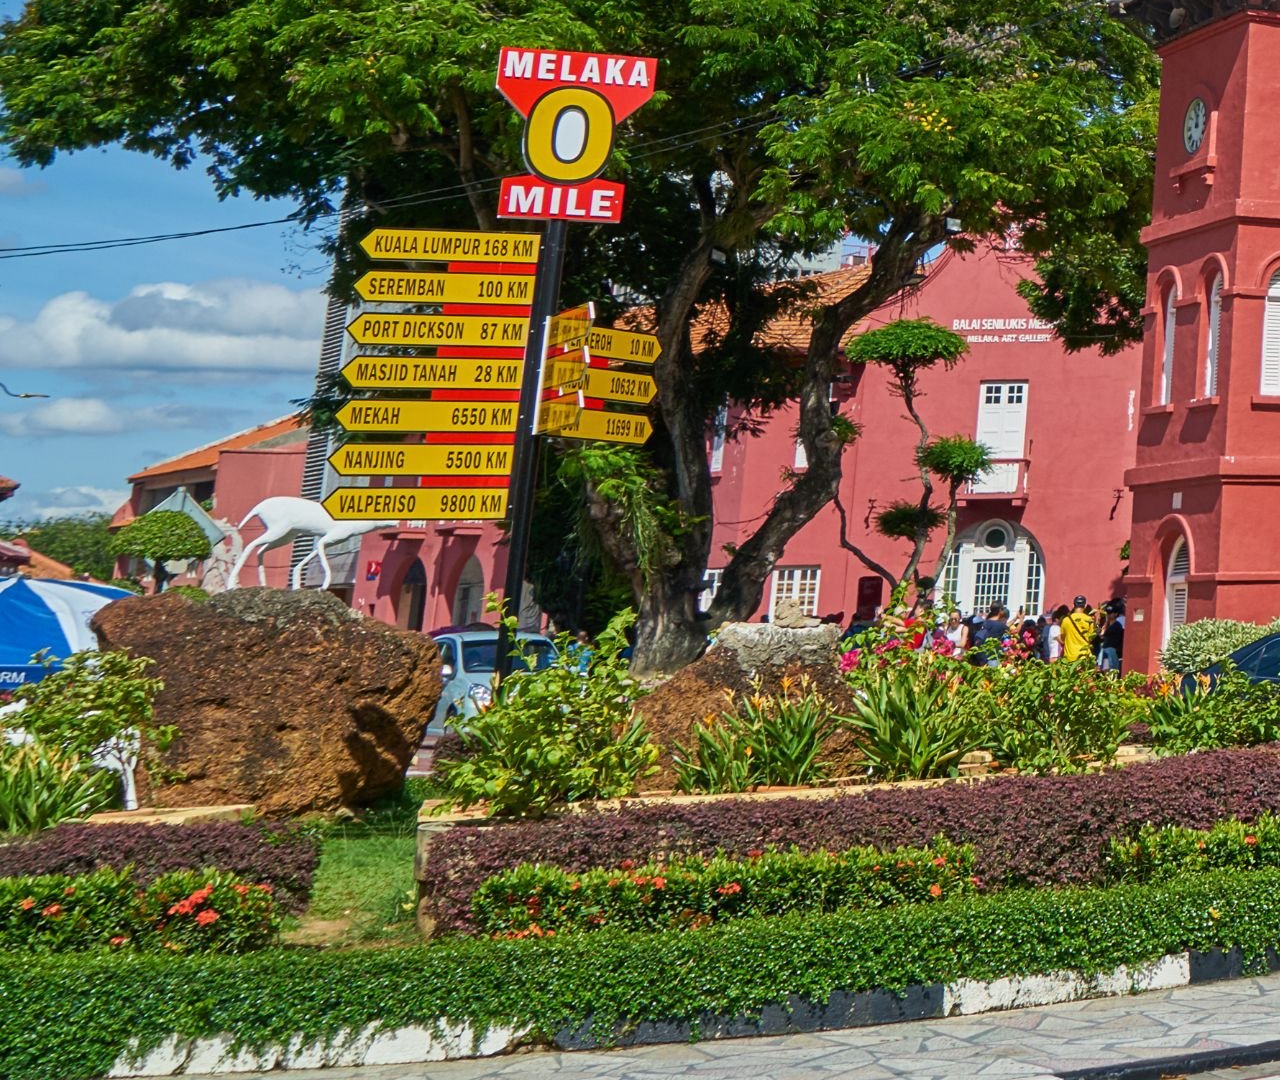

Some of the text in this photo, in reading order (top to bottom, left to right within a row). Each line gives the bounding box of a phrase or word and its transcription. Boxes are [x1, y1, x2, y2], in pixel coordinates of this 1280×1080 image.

[504, 50, 649, 87] MELAKA
[508, 185, 616, 217] MILE
[374, 235, 533, 257] KUALA LUMPUR 168 KM
[368, 277, 528, 299] SEREMBAN 100 KM
[362, 320, 523, 341] PORT DICKSON 87 KM
[953, 319, 980, 330] BALAI
[630, 338, 641, 355] 10
[641, 340, 655, 357] KM
[967, 333, 1052, 343] MELAKA ART GALLERY
[356, 363, 518, 383] MASJID TANAH 28 KM
[610, 376, 636, 395] 10632
[637, 380, 650, 398] KM
[350, 407, 512, 426] MEKAH 6550 KM
[605, 418, 646, 438] 11699 KM
[343, 450, 507, 469] NANJING 5500 KM
[339, 494, 502, 513] VALPERISO 9800 KM
